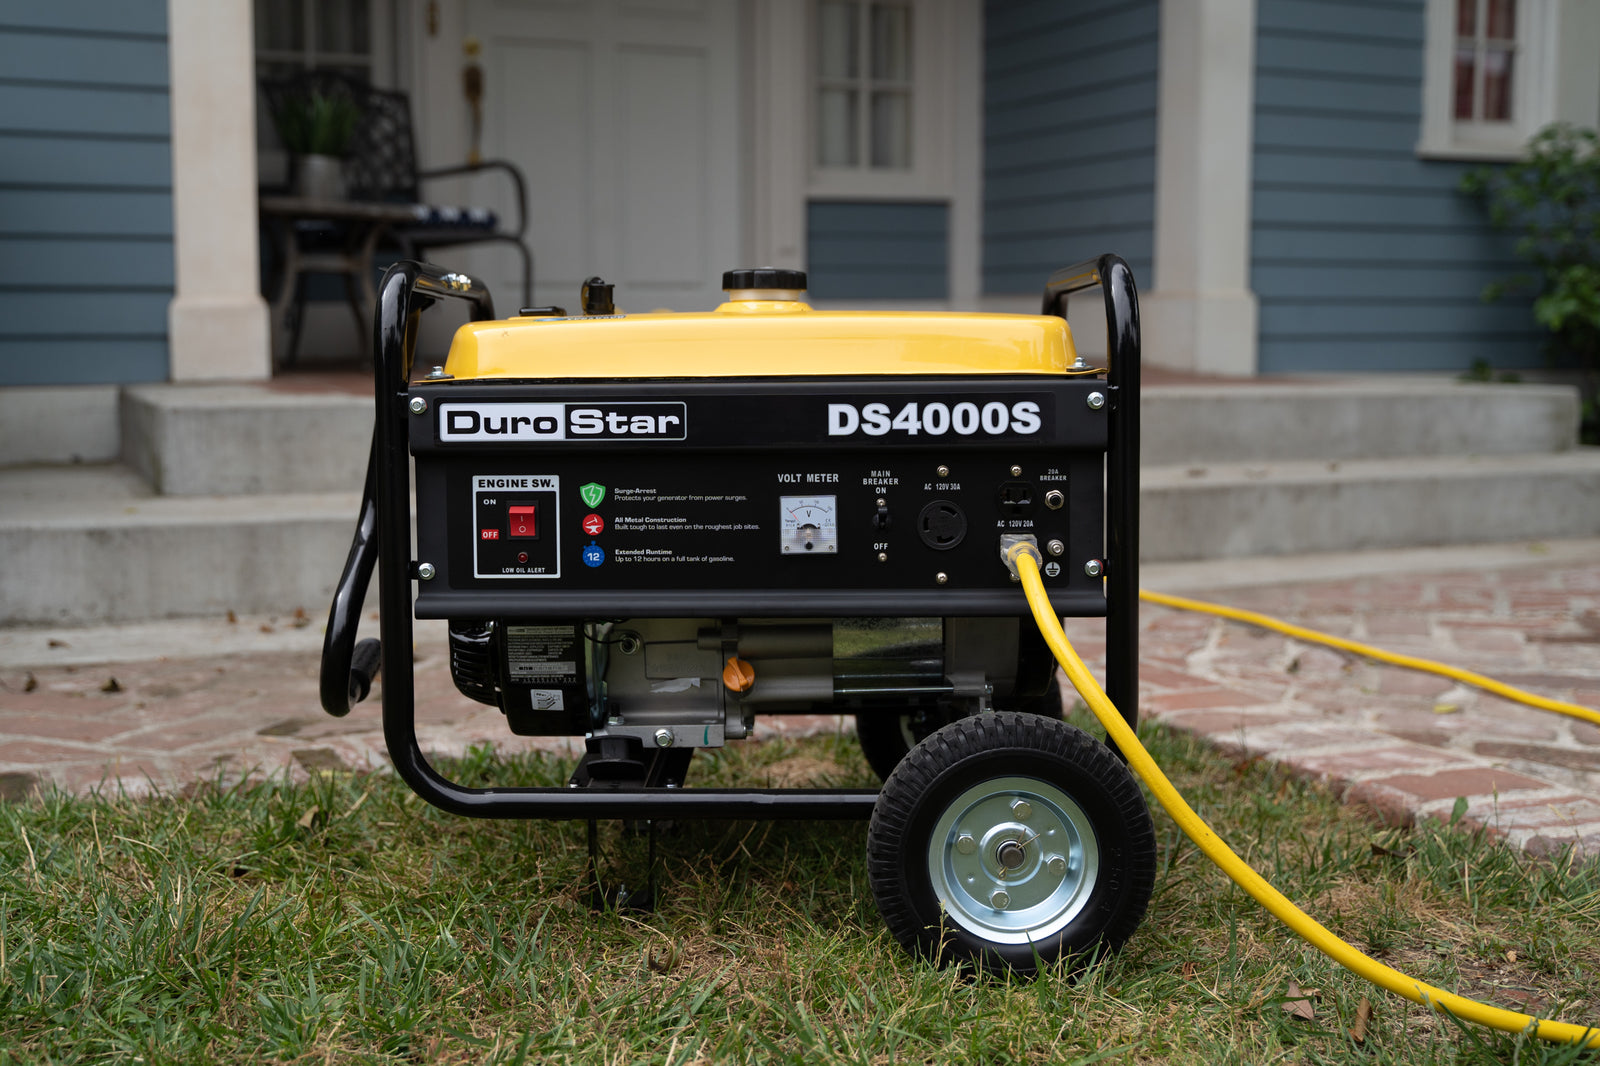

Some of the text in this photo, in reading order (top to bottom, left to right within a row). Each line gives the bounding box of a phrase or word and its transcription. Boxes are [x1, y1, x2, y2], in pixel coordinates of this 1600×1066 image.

[828, 401, 1042, 436] DS4000S
[777, 473, 839, 483] VOLT METER
[870, 470, 891, 478] MAIN
[478, 479, 555, 488] ENGINE SW.
[862, 477, 899, 486] BREAKER
[875, 486, 887, 494] ON
[924, 483, 961, 491] AC 120V 30A
[806, 509, 812, 518] V
[997, 520, 1034, 528] AC 120V 20A
[873, 543, 889, 551] OFF
[587, 552, 600, 561] 12
